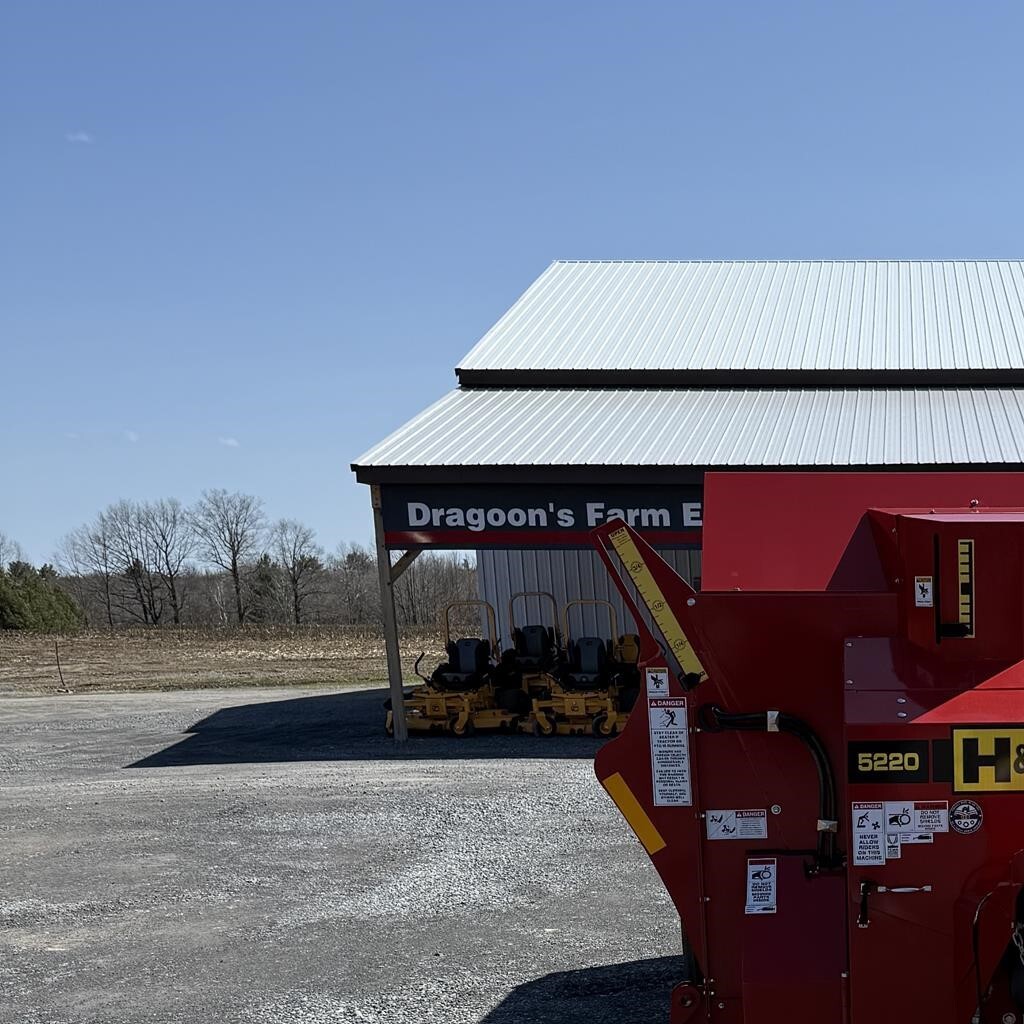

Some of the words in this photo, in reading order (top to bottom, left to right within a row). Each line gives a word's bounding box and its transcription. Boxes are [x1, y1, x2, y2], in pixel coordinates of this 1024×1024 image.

[407, 502, 575, 532] Dragoon's
[586, 502, 671, 527] Farm
[858, 752, 920, 772] 5220
